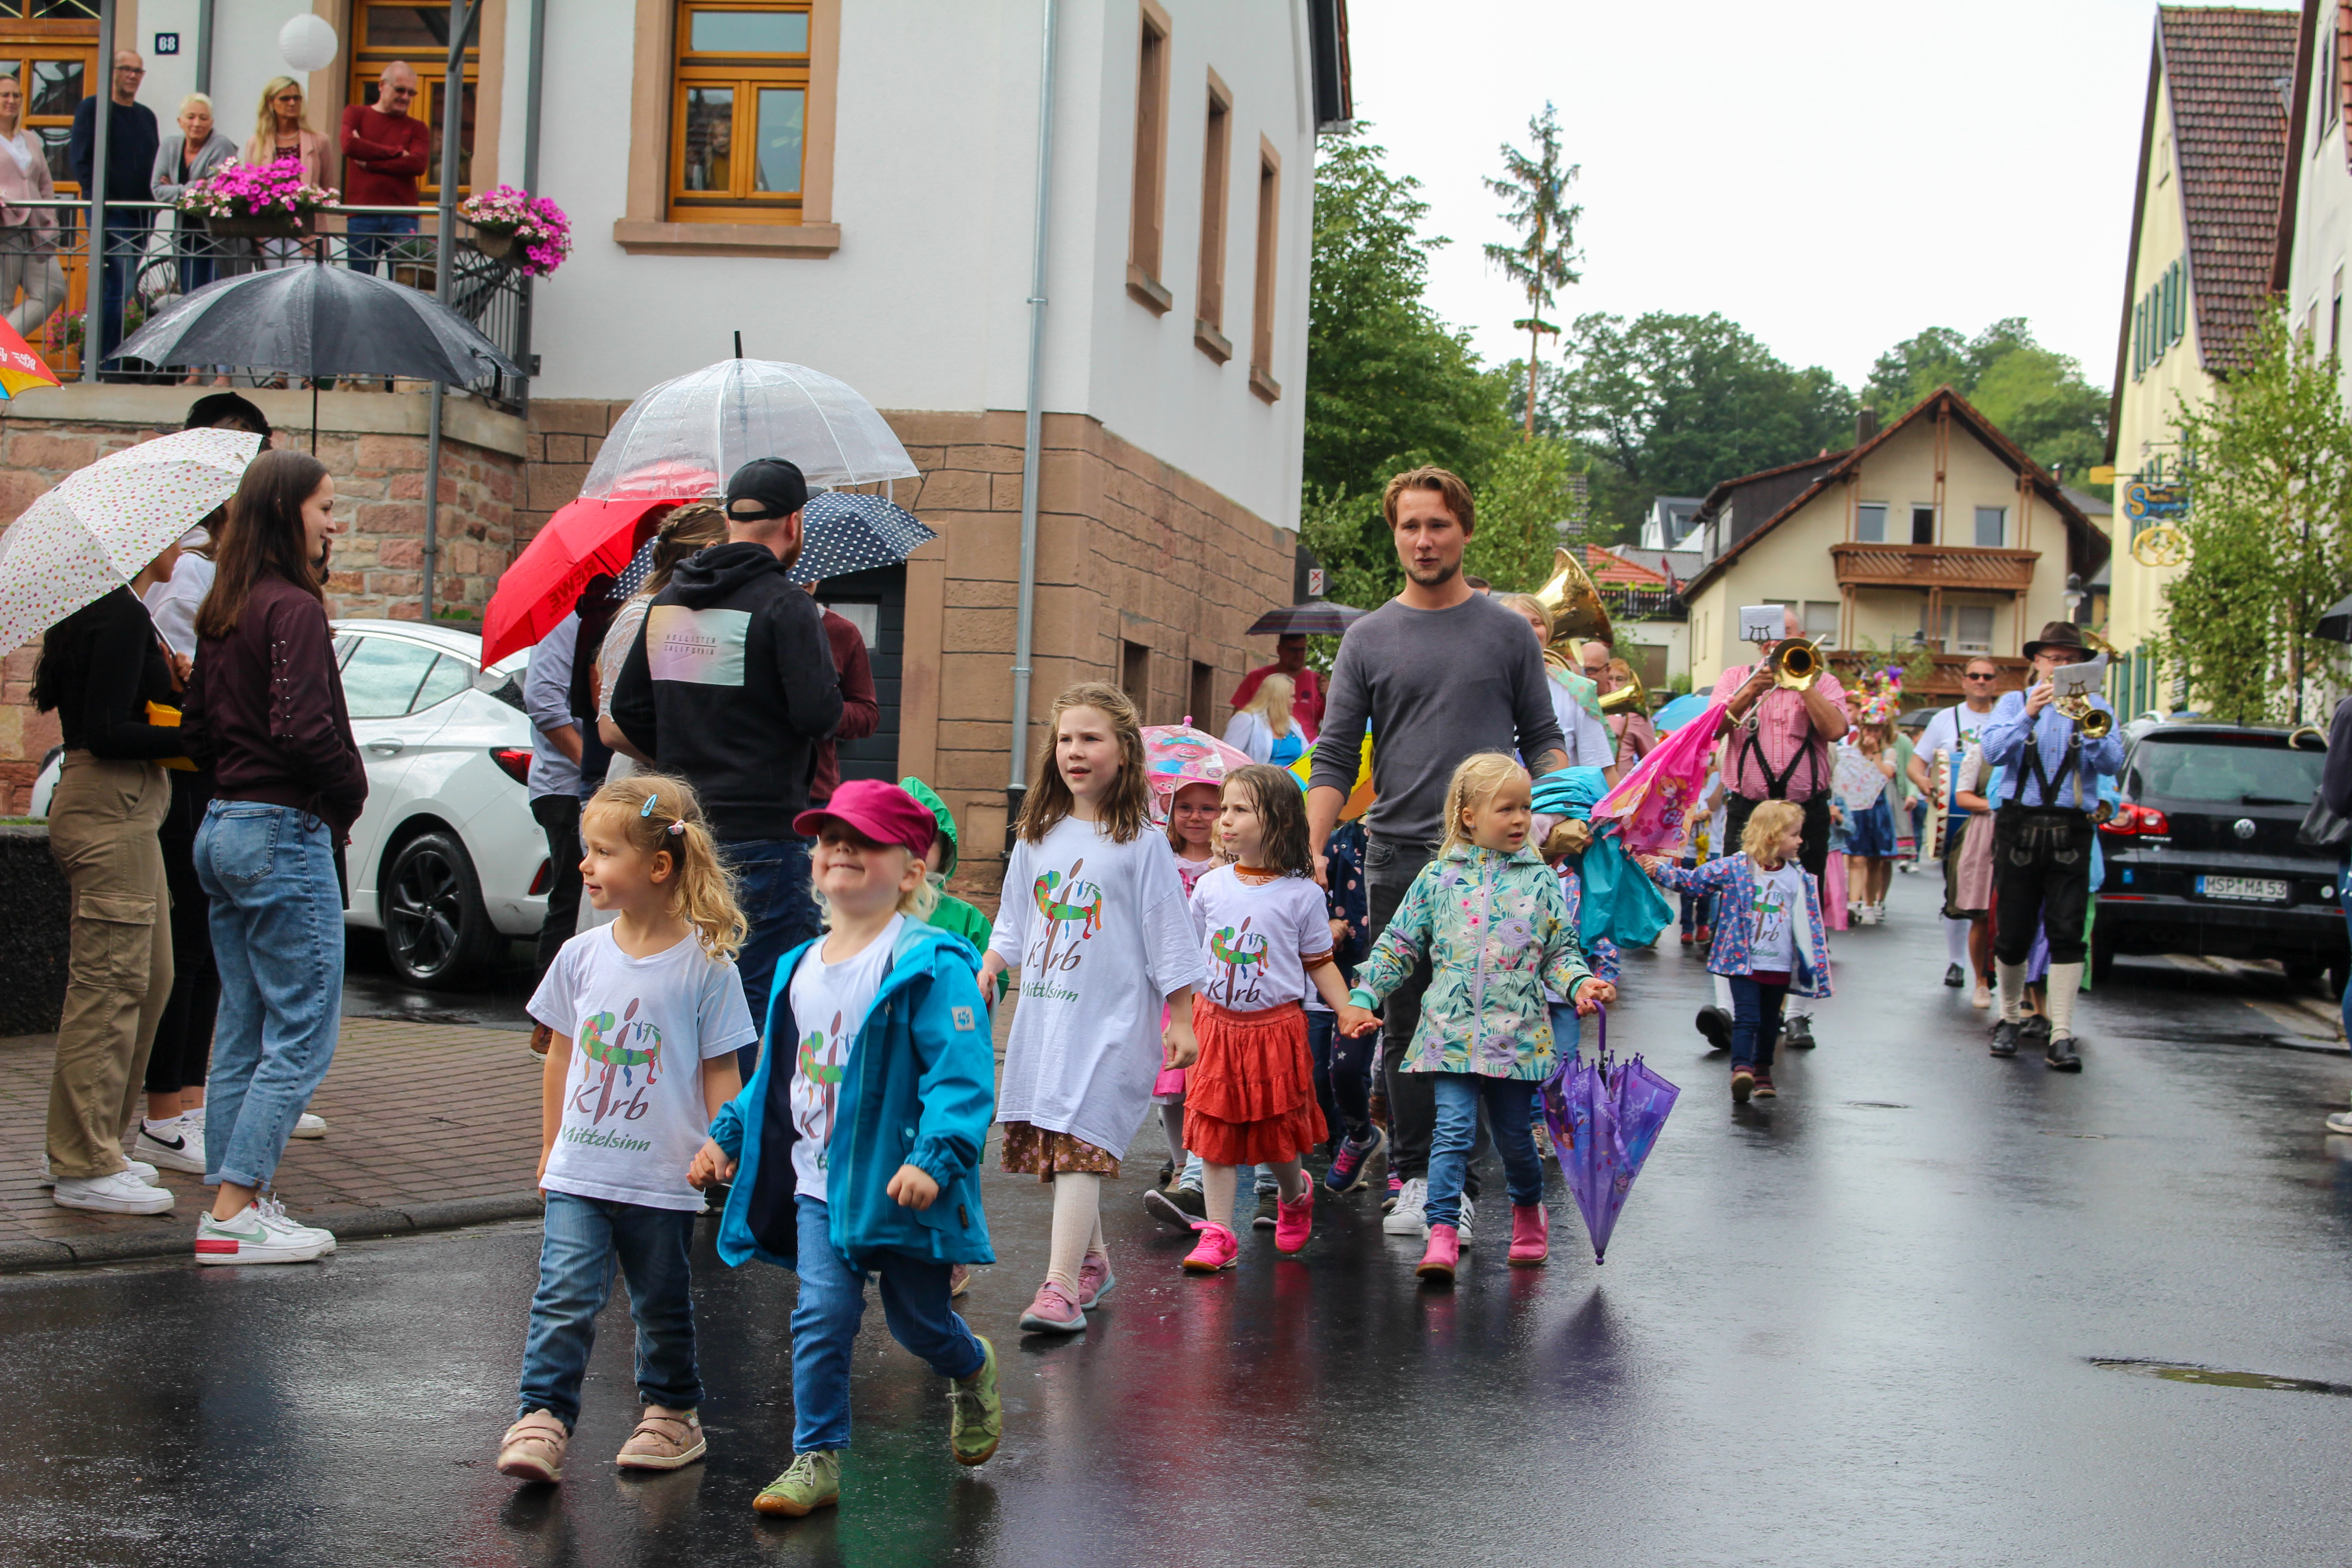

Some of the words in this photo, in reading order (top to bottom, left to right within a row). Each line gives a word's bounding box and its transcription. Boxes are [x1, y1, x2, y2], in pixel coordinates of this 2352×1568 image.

[158, 36, 176, 51] 68
[666, 634, 716, 644] HOLLISTER
[664, 645, 714, 655] CALIFORNIA
[2206, 877, 2235, 892] MSP
[2245, 880, 2264, 894] MA
[2267, 881, 2286, 896] 53
[562, 1124, 651, 1152] Mittelsinn
